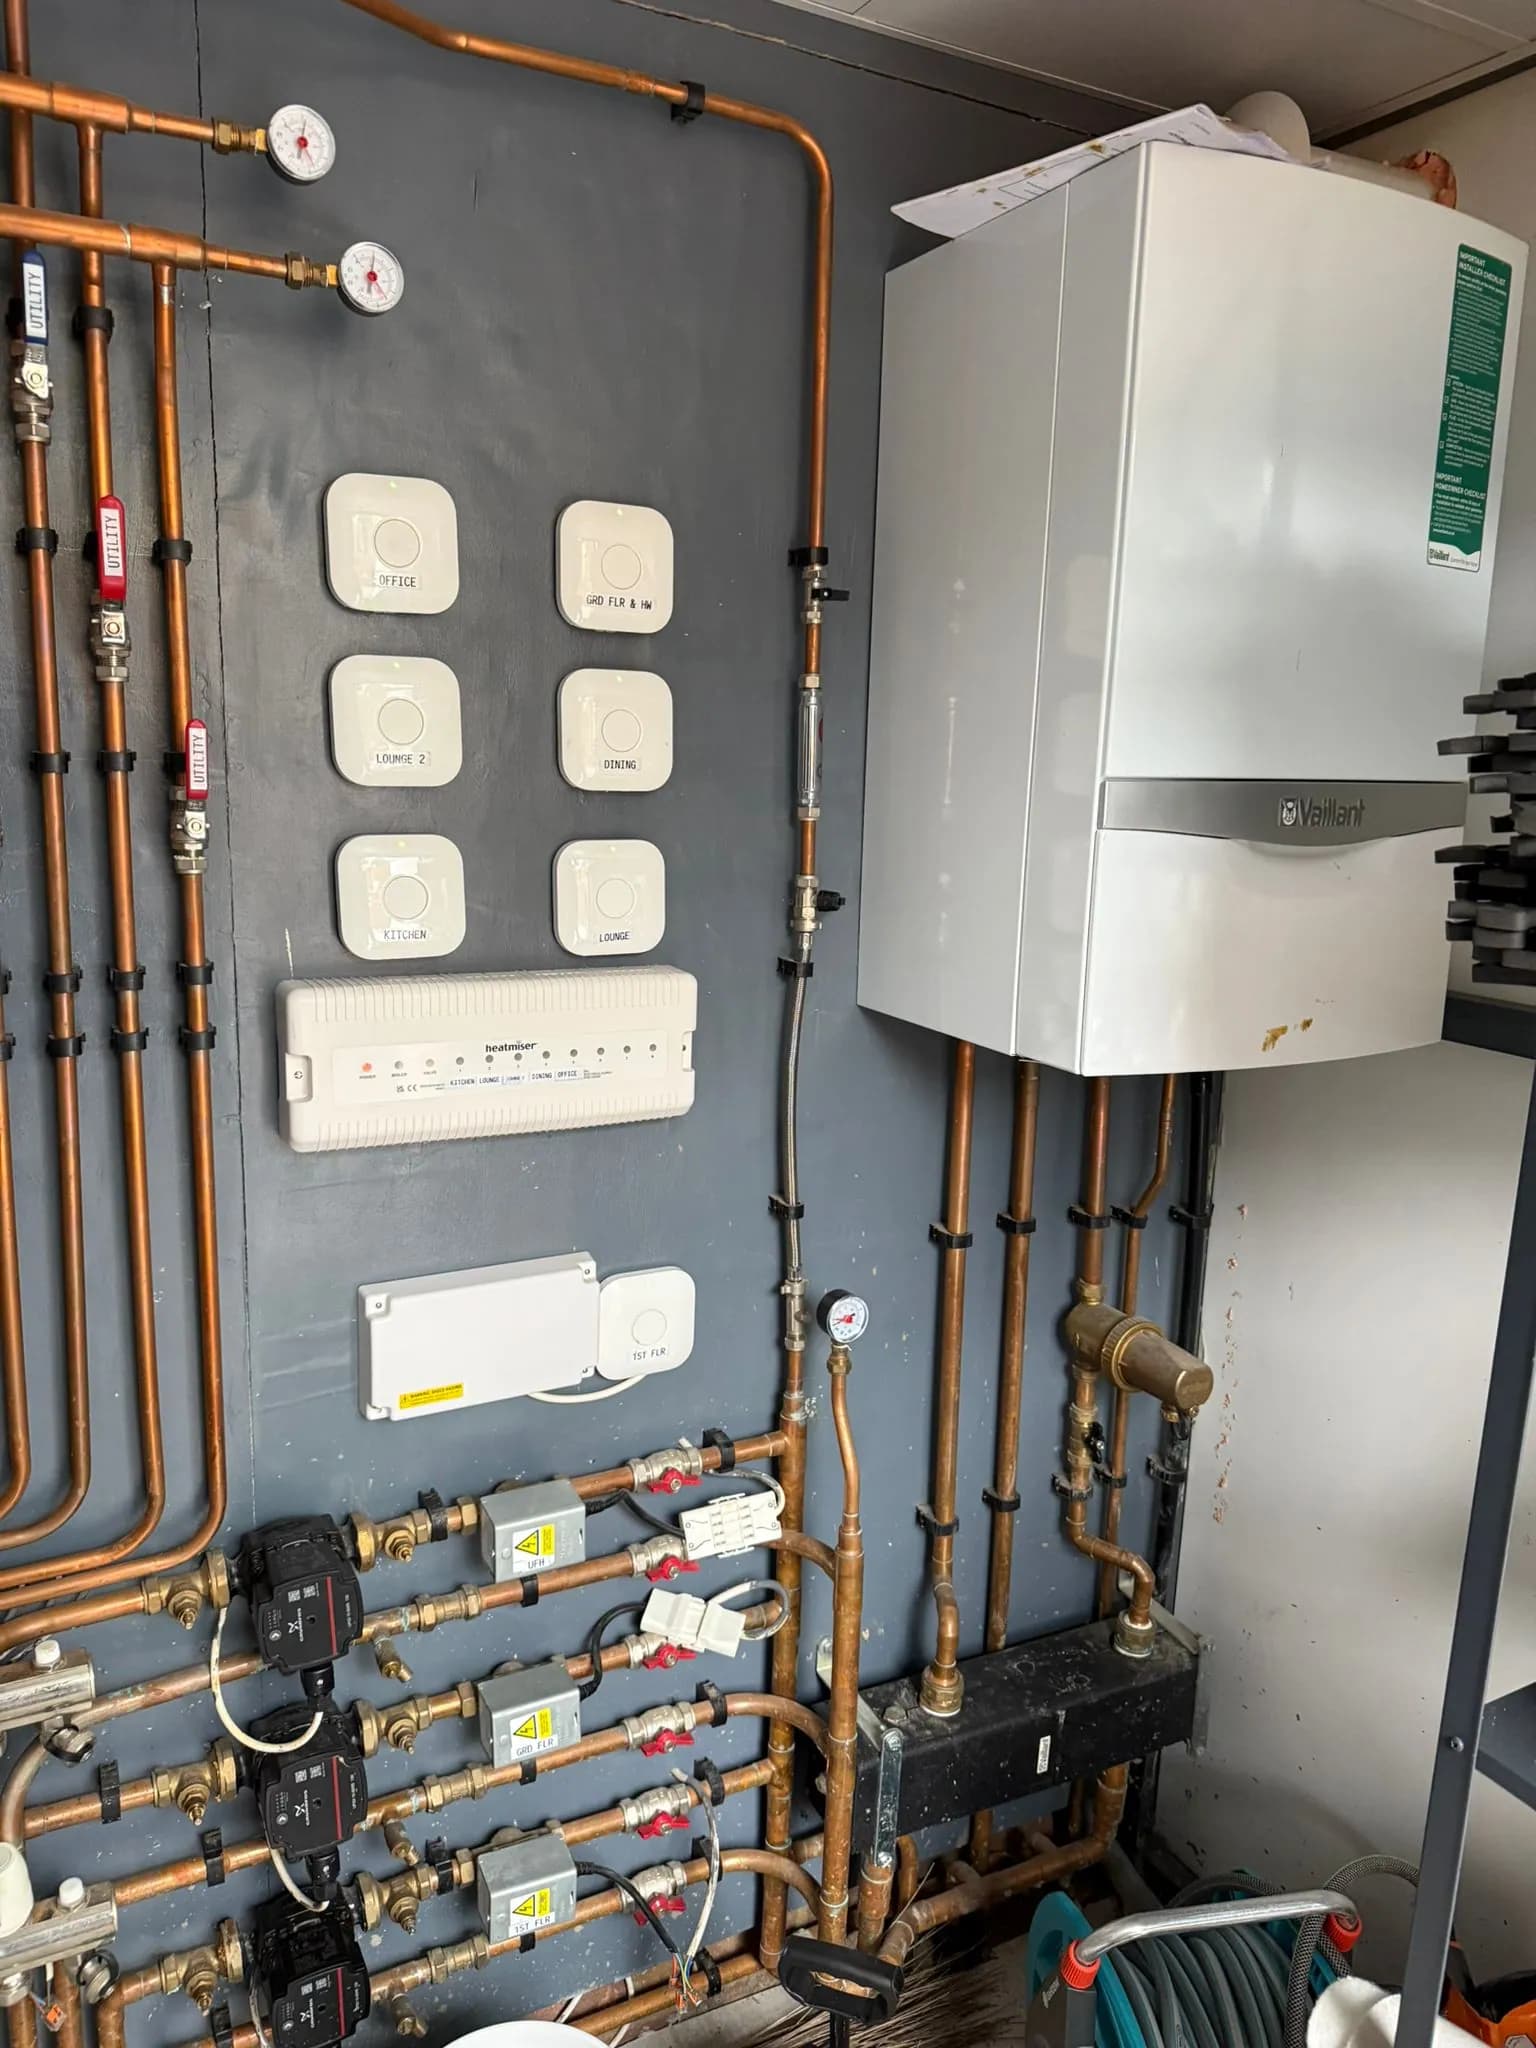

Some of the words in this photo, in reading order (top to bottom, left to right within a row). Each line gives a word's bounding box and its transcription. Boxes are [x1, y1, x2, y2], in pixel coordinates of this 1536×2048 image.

[28, 271, 44, 329] UTILITY
[105, 515, 120, 569] UTILITY
[379, 574, 417, 588] OFFICE
[586, 595, 604, 606] GRD
[608, 596, 625, 608] FLR
[629, 598, 636, 609] &
[641, 599, 653, 611] HW
[192, 734, 205, 783] UTILITY
[376, 754, 413, 765] LOUNGE
[418, 753, 426, 765] 2
[604, 759, 637, 769] DINING
[1298, 797, 1365, 827] Vaillant
[383, 929, 427, 940] KITCHEN
[599, 931, 631, 942] LOUNGE
[485, 1040, 538, 1052] heatmiser
[532, 1072, 553, 1080] DINING
[557, 1069, 577, 1078] OFFICE
[633, 1350, 646, 1361] 1ST
[651, 1347, 666, 1358] FLR
[527, 1557, 545, 1569] UFH
[537, 1738, 554, 1750] FLR
